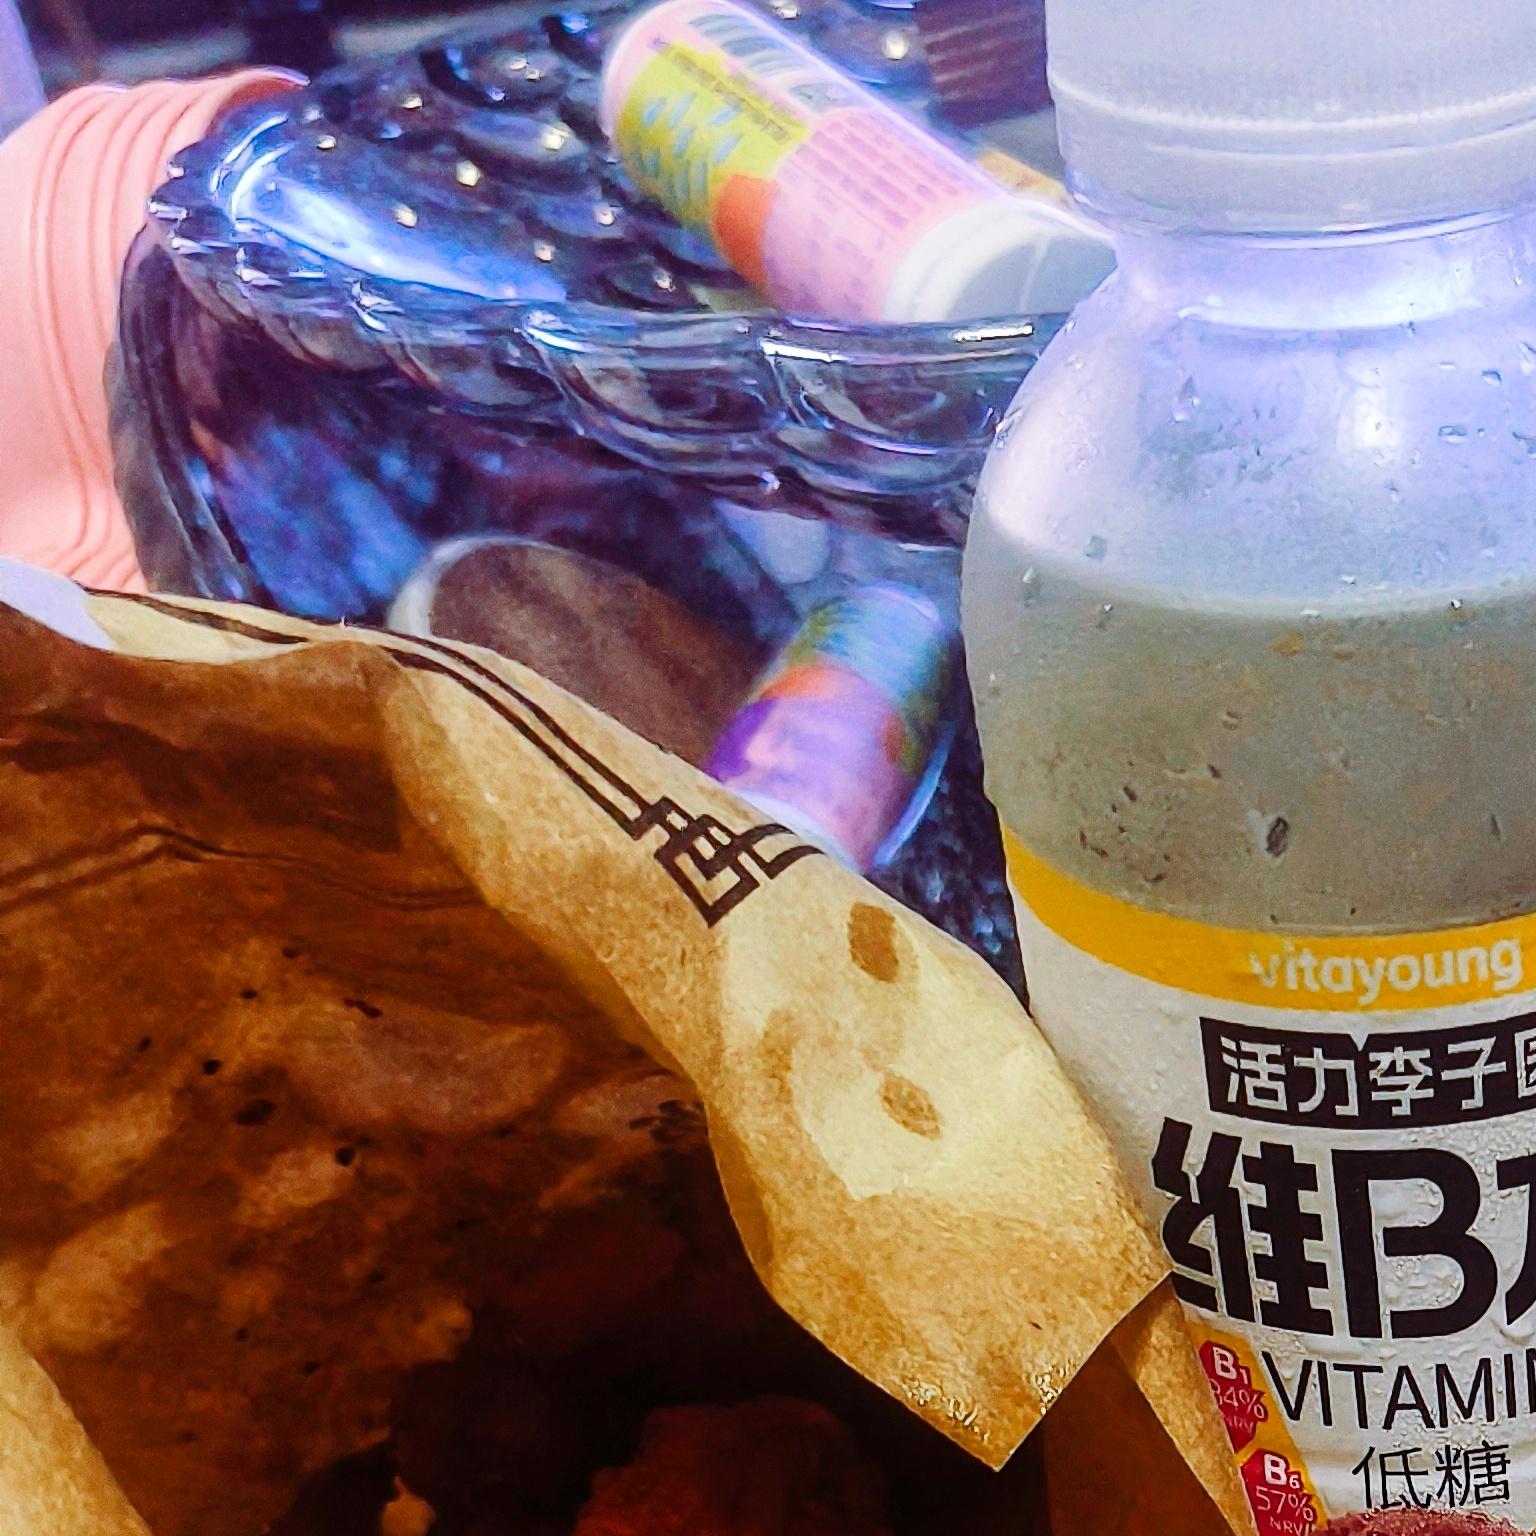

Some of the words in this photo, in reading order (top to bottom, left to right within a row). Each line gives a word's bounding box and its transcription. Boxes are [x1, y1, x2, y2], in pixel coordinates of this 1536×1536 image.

[1250, 939, 1523, 1005] vitayoung
[1213, 1347, 1249, 1385] B1
[1263, 1453, 1300, 1489] B6
[1352, 1440, 1511, 1508] 低糖
[1256, 1485, 1314, 1522] 57%
